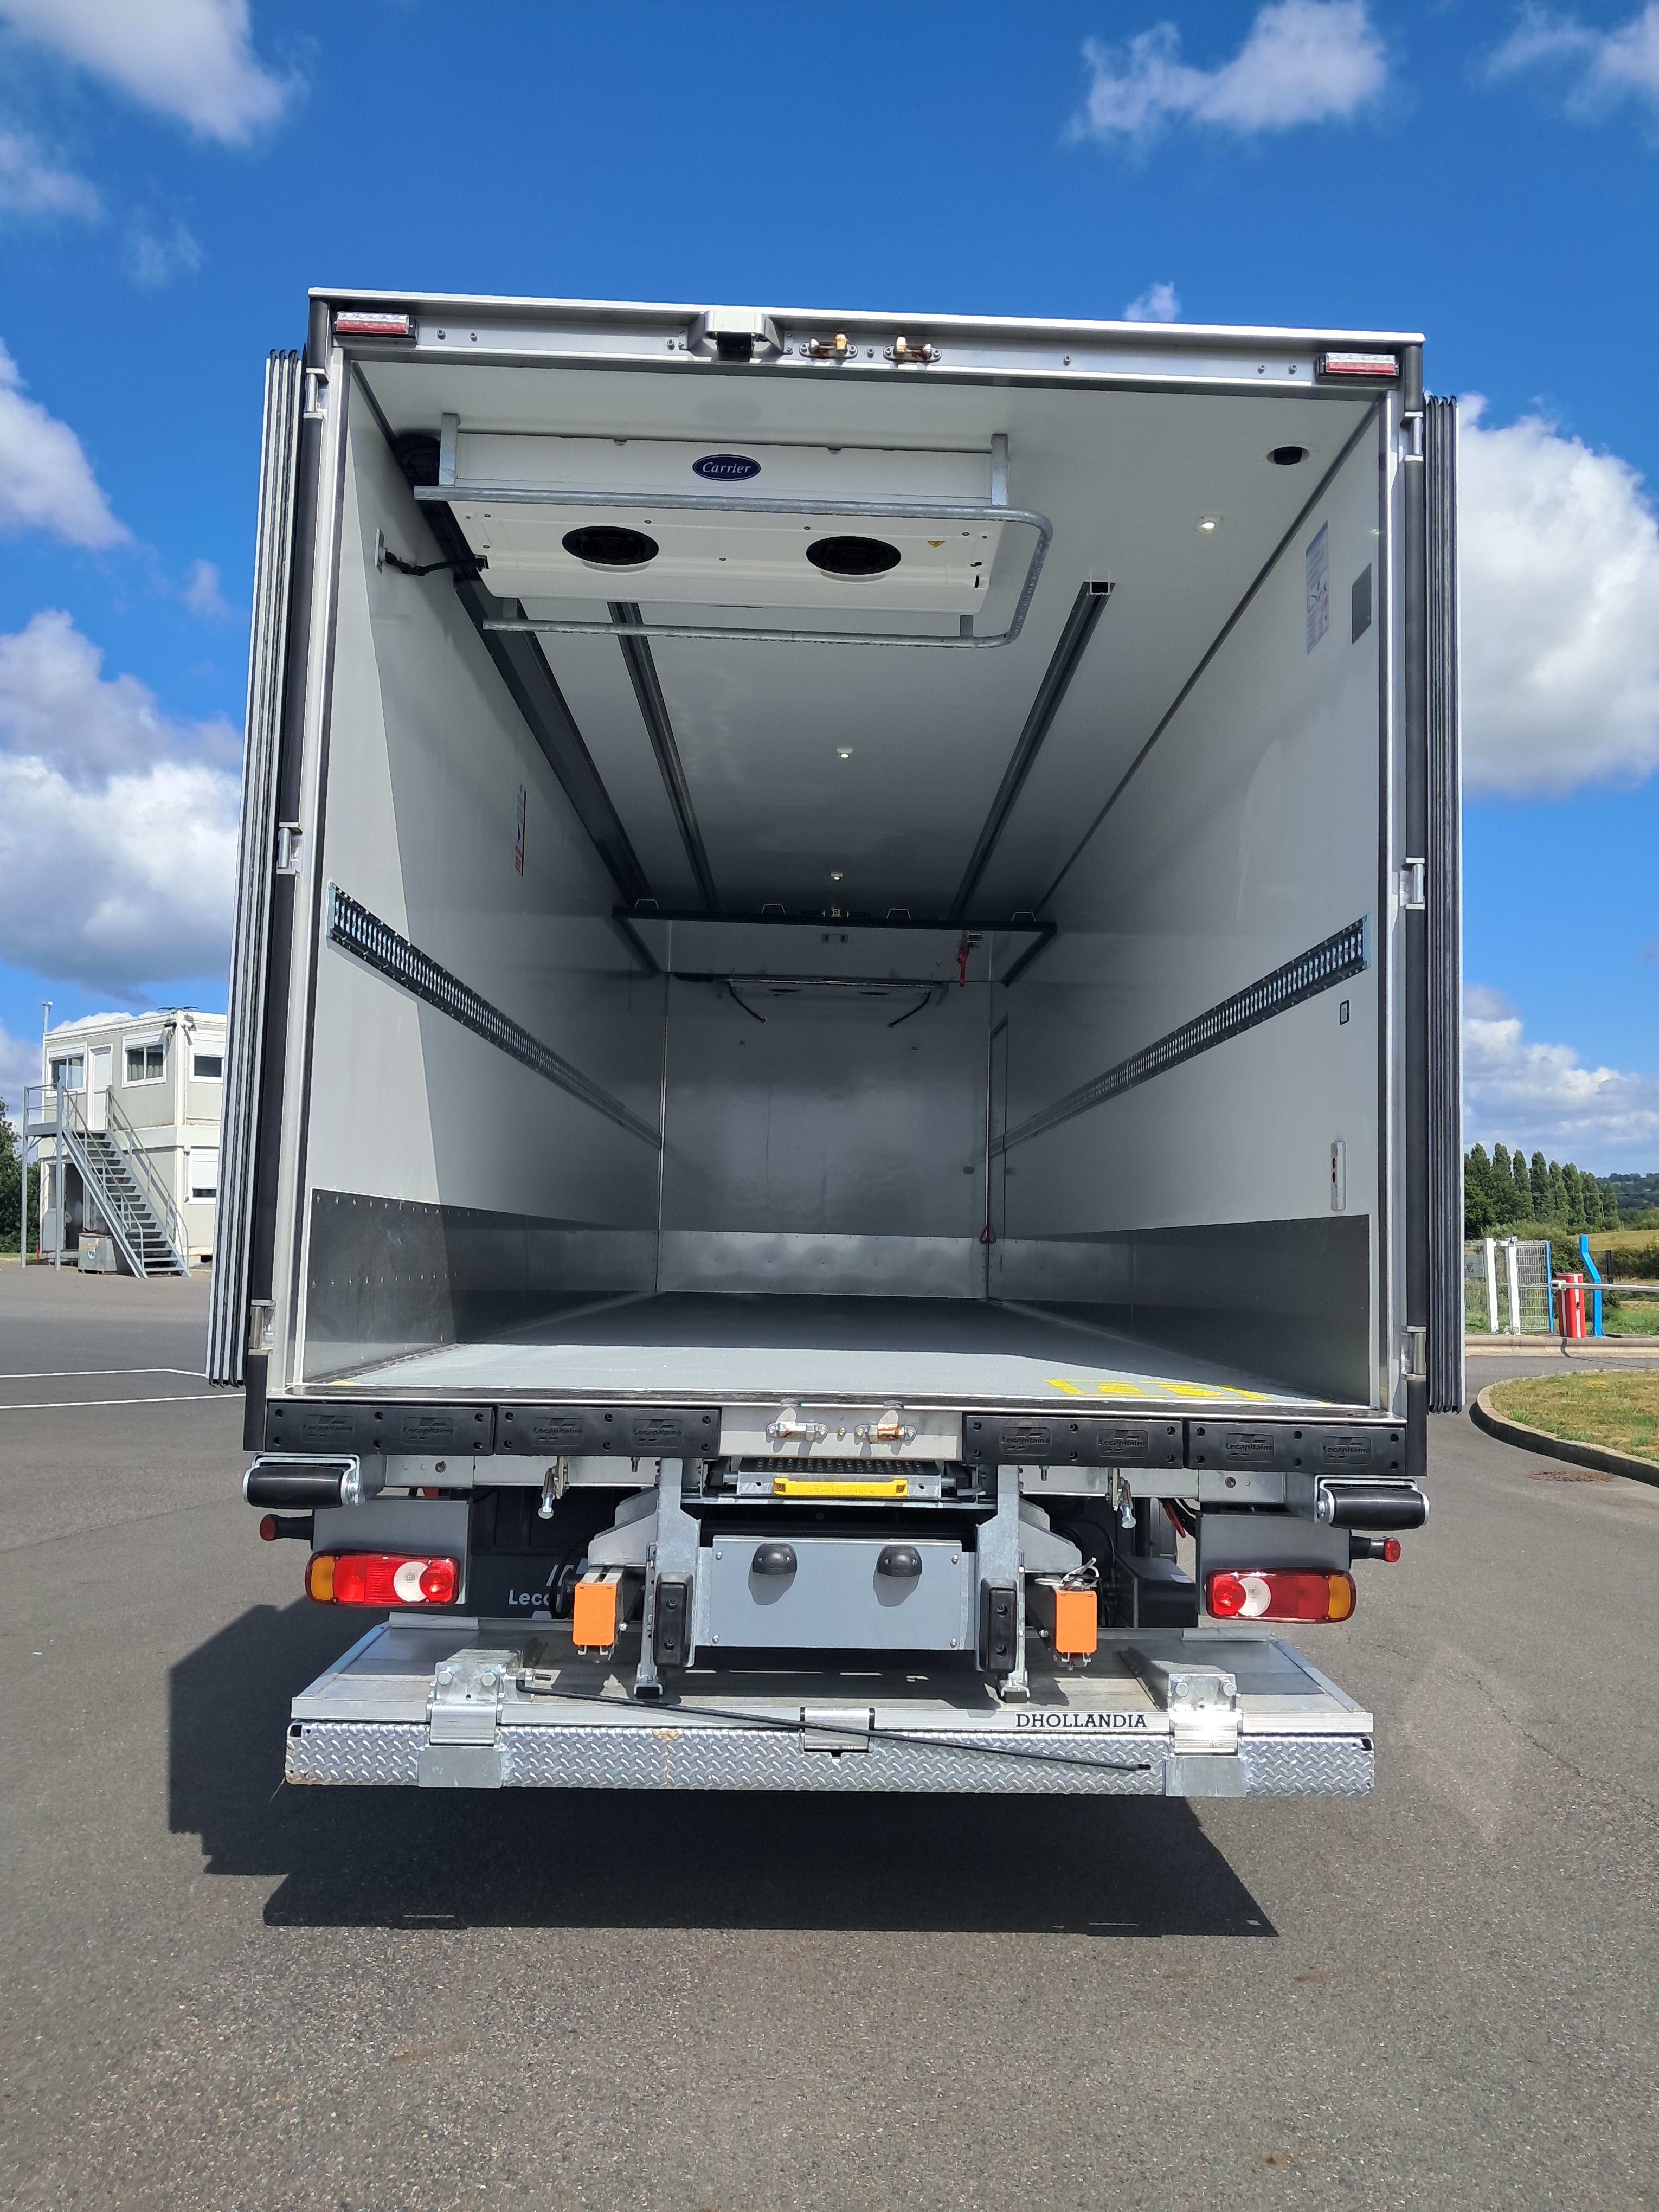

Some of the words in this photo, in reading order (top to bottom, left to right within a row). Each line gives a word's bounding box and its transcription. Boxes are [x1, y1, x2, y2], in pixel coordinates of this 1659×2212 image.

[703, 462, 751, 473] Carrier
[303, 1424, 352, 1433] Lecapitaine
[403, 1426, 453, 1436] Lecapitaine
[533, 1427, 583, 1437] Lecapitaine
[633, 1428, 681, 1437] Lecapitaine
[1001, 1436, 1050, 1447] Lecapitaine
[1098, 1438, 1147, 1449] Lecapitaine
[1226, 1443, 1273, 1452] Lecapitaine
[1323, 1445, 1371, 1455] Lecapitaine
[807, 1483, 875, 1494] LECAPITAINE
[1015, 1713, 1148, 1728] DHOLLANDIA
